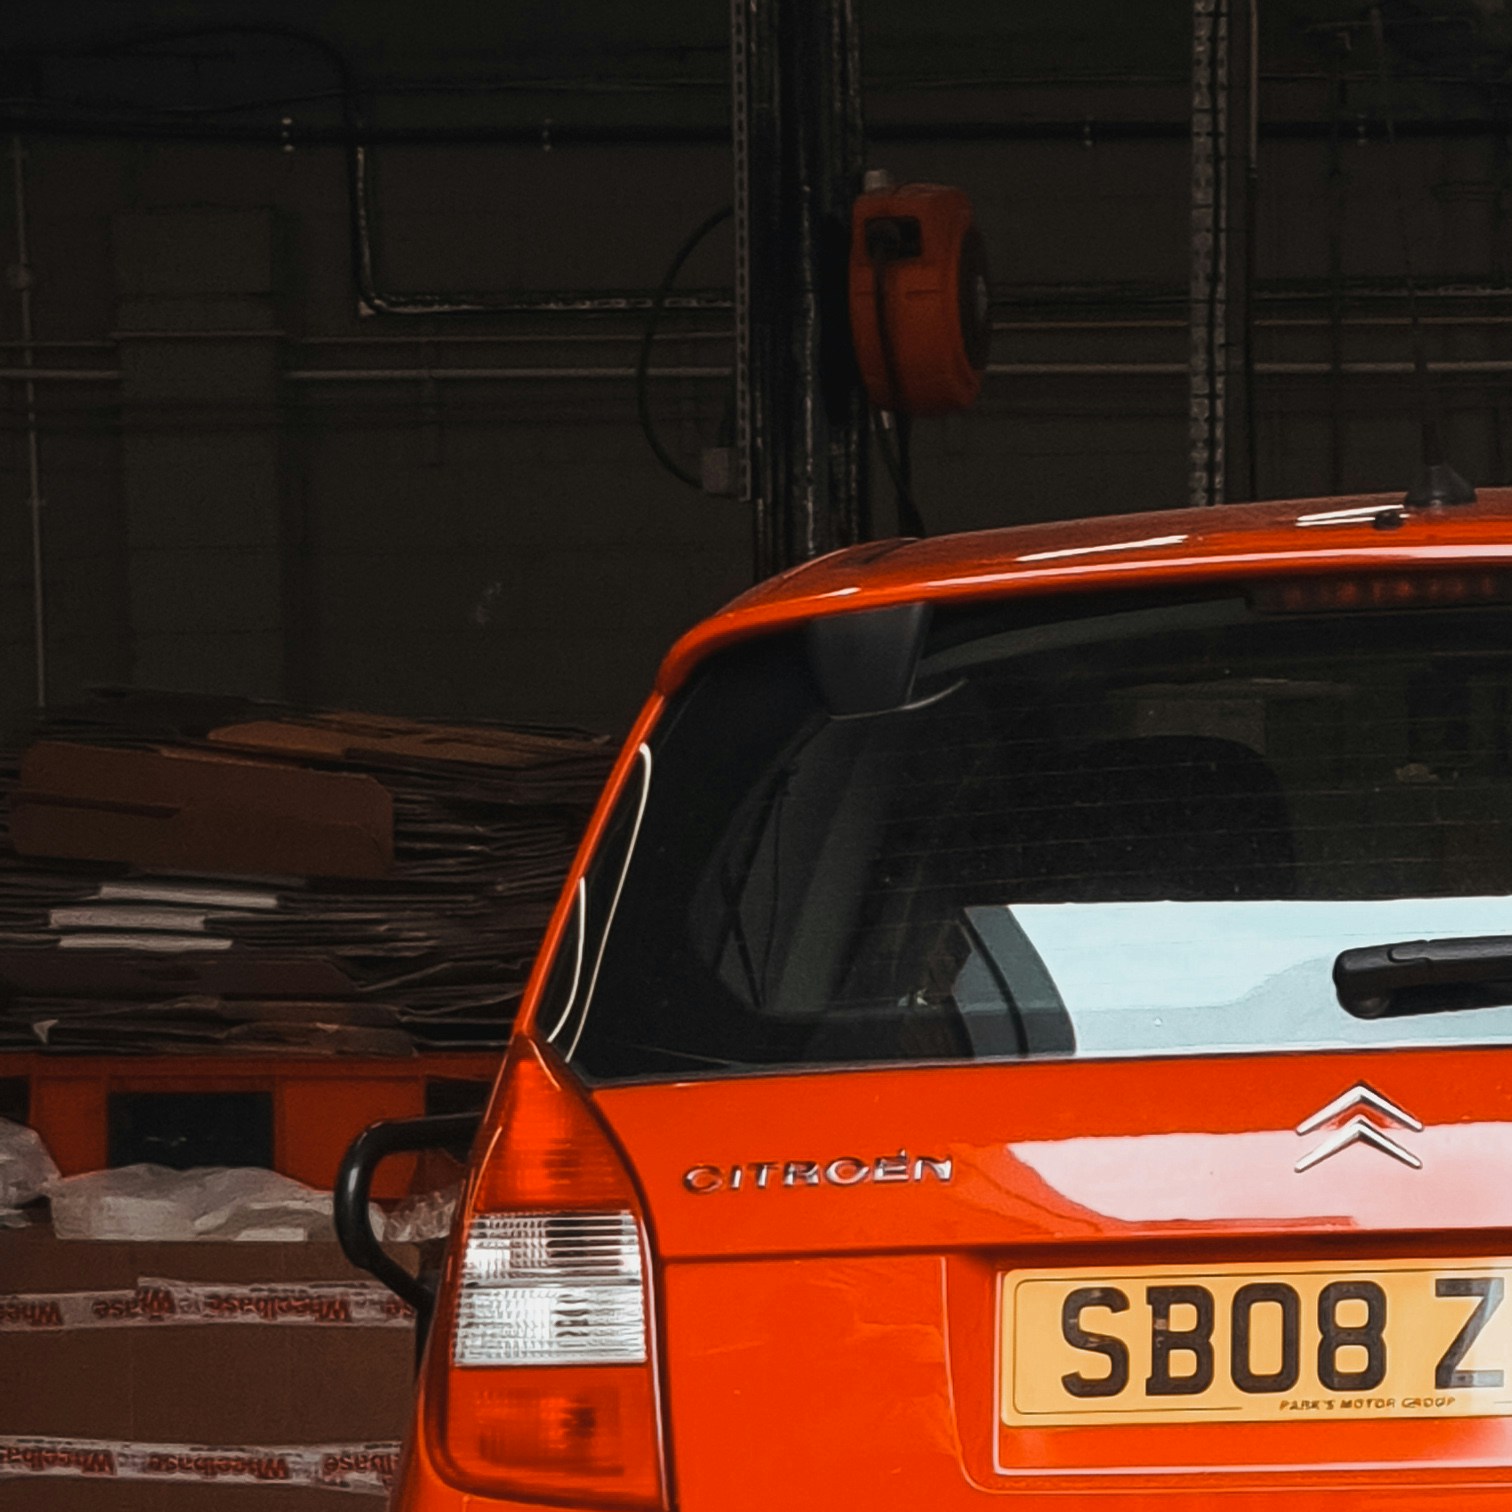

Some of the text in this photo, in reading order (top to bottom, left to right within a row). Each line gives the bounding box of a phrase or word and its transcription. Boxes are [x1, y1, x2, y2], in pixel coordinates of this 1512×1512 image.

[203, 1296, 352, 1324] Wheelbase
[1061, 1279, 1388, 1398] SB08
[1339, 1398, 1396, 1410] MOTOR
[1400, 1396, 1457, 1409] GROUP
[146, 1453, 290, 1480] Wheelbase
